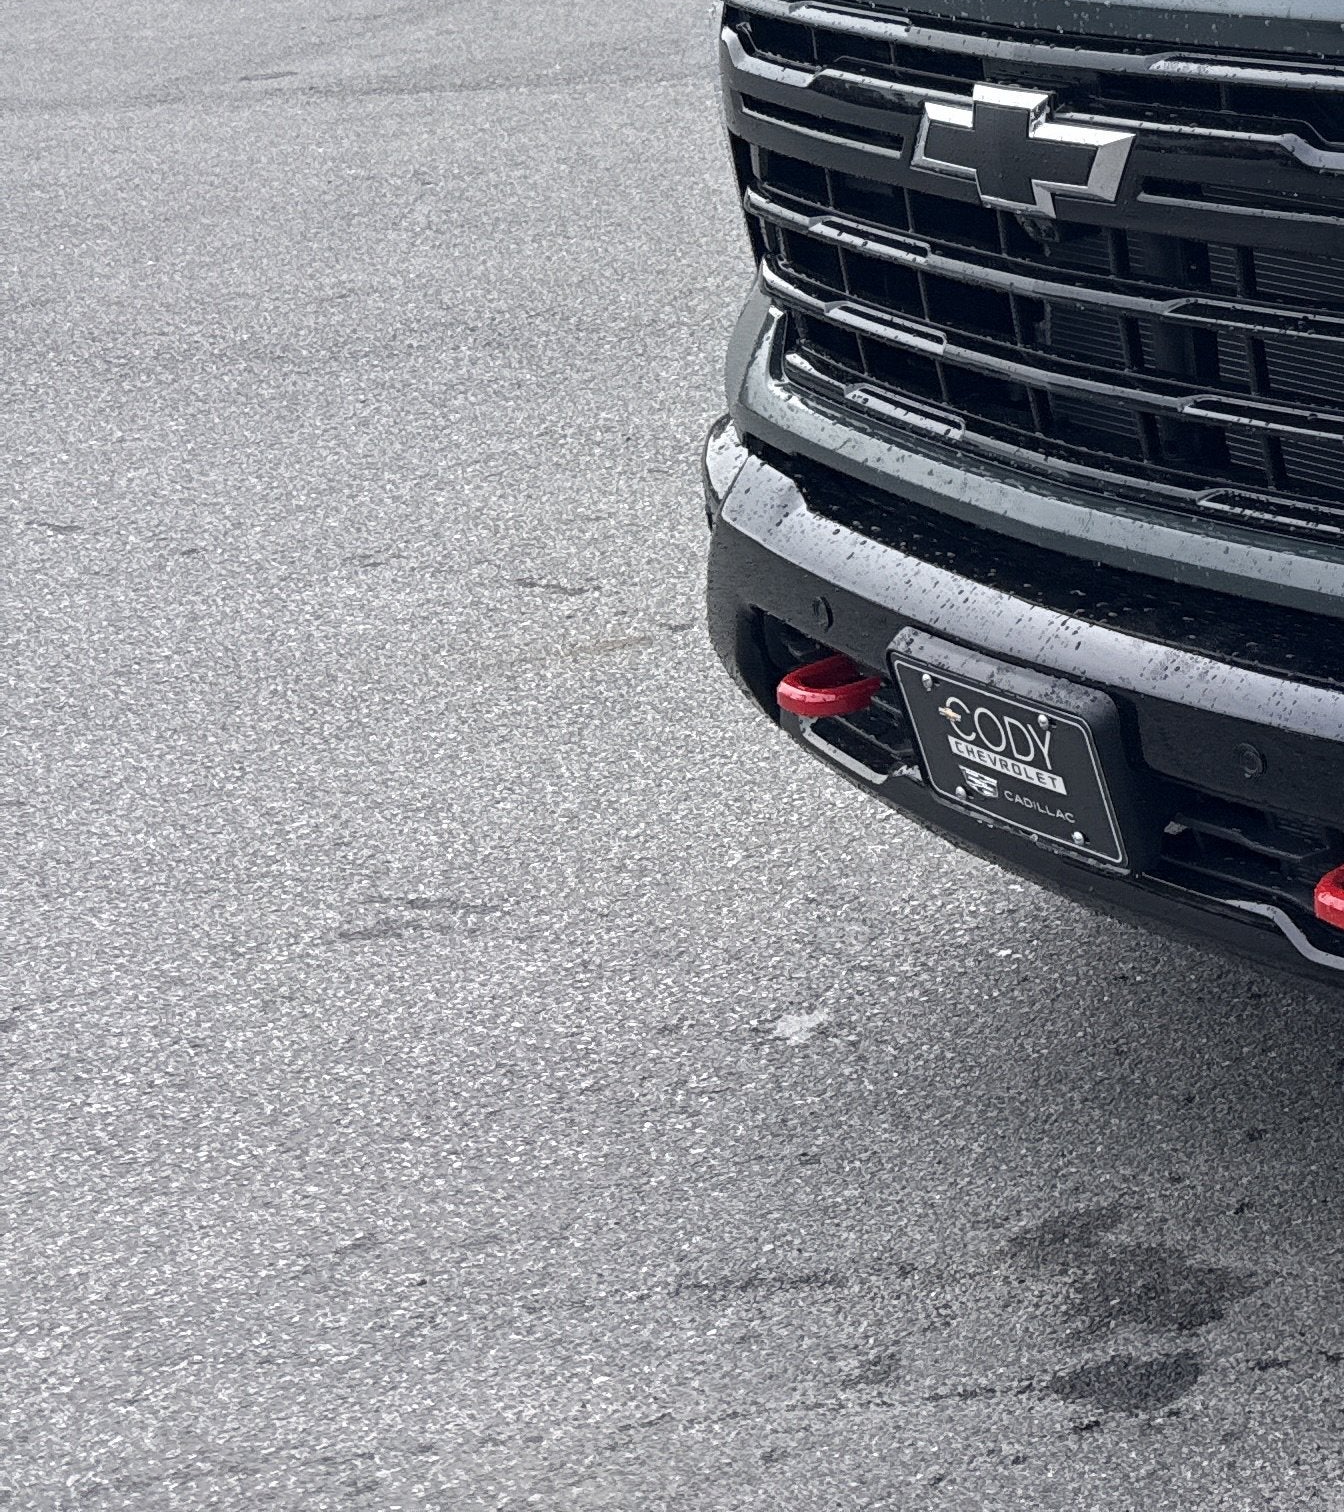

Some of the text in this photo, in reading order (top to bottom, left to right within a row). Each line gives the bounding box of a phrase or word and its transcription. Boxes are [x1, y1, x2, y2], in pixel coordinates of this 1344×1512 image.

[943, 696, 1053, 771] CODY
[954, 742, 1060, 793] CHEVROLET
[1003, 789, 1076, 824] CADILLAC
